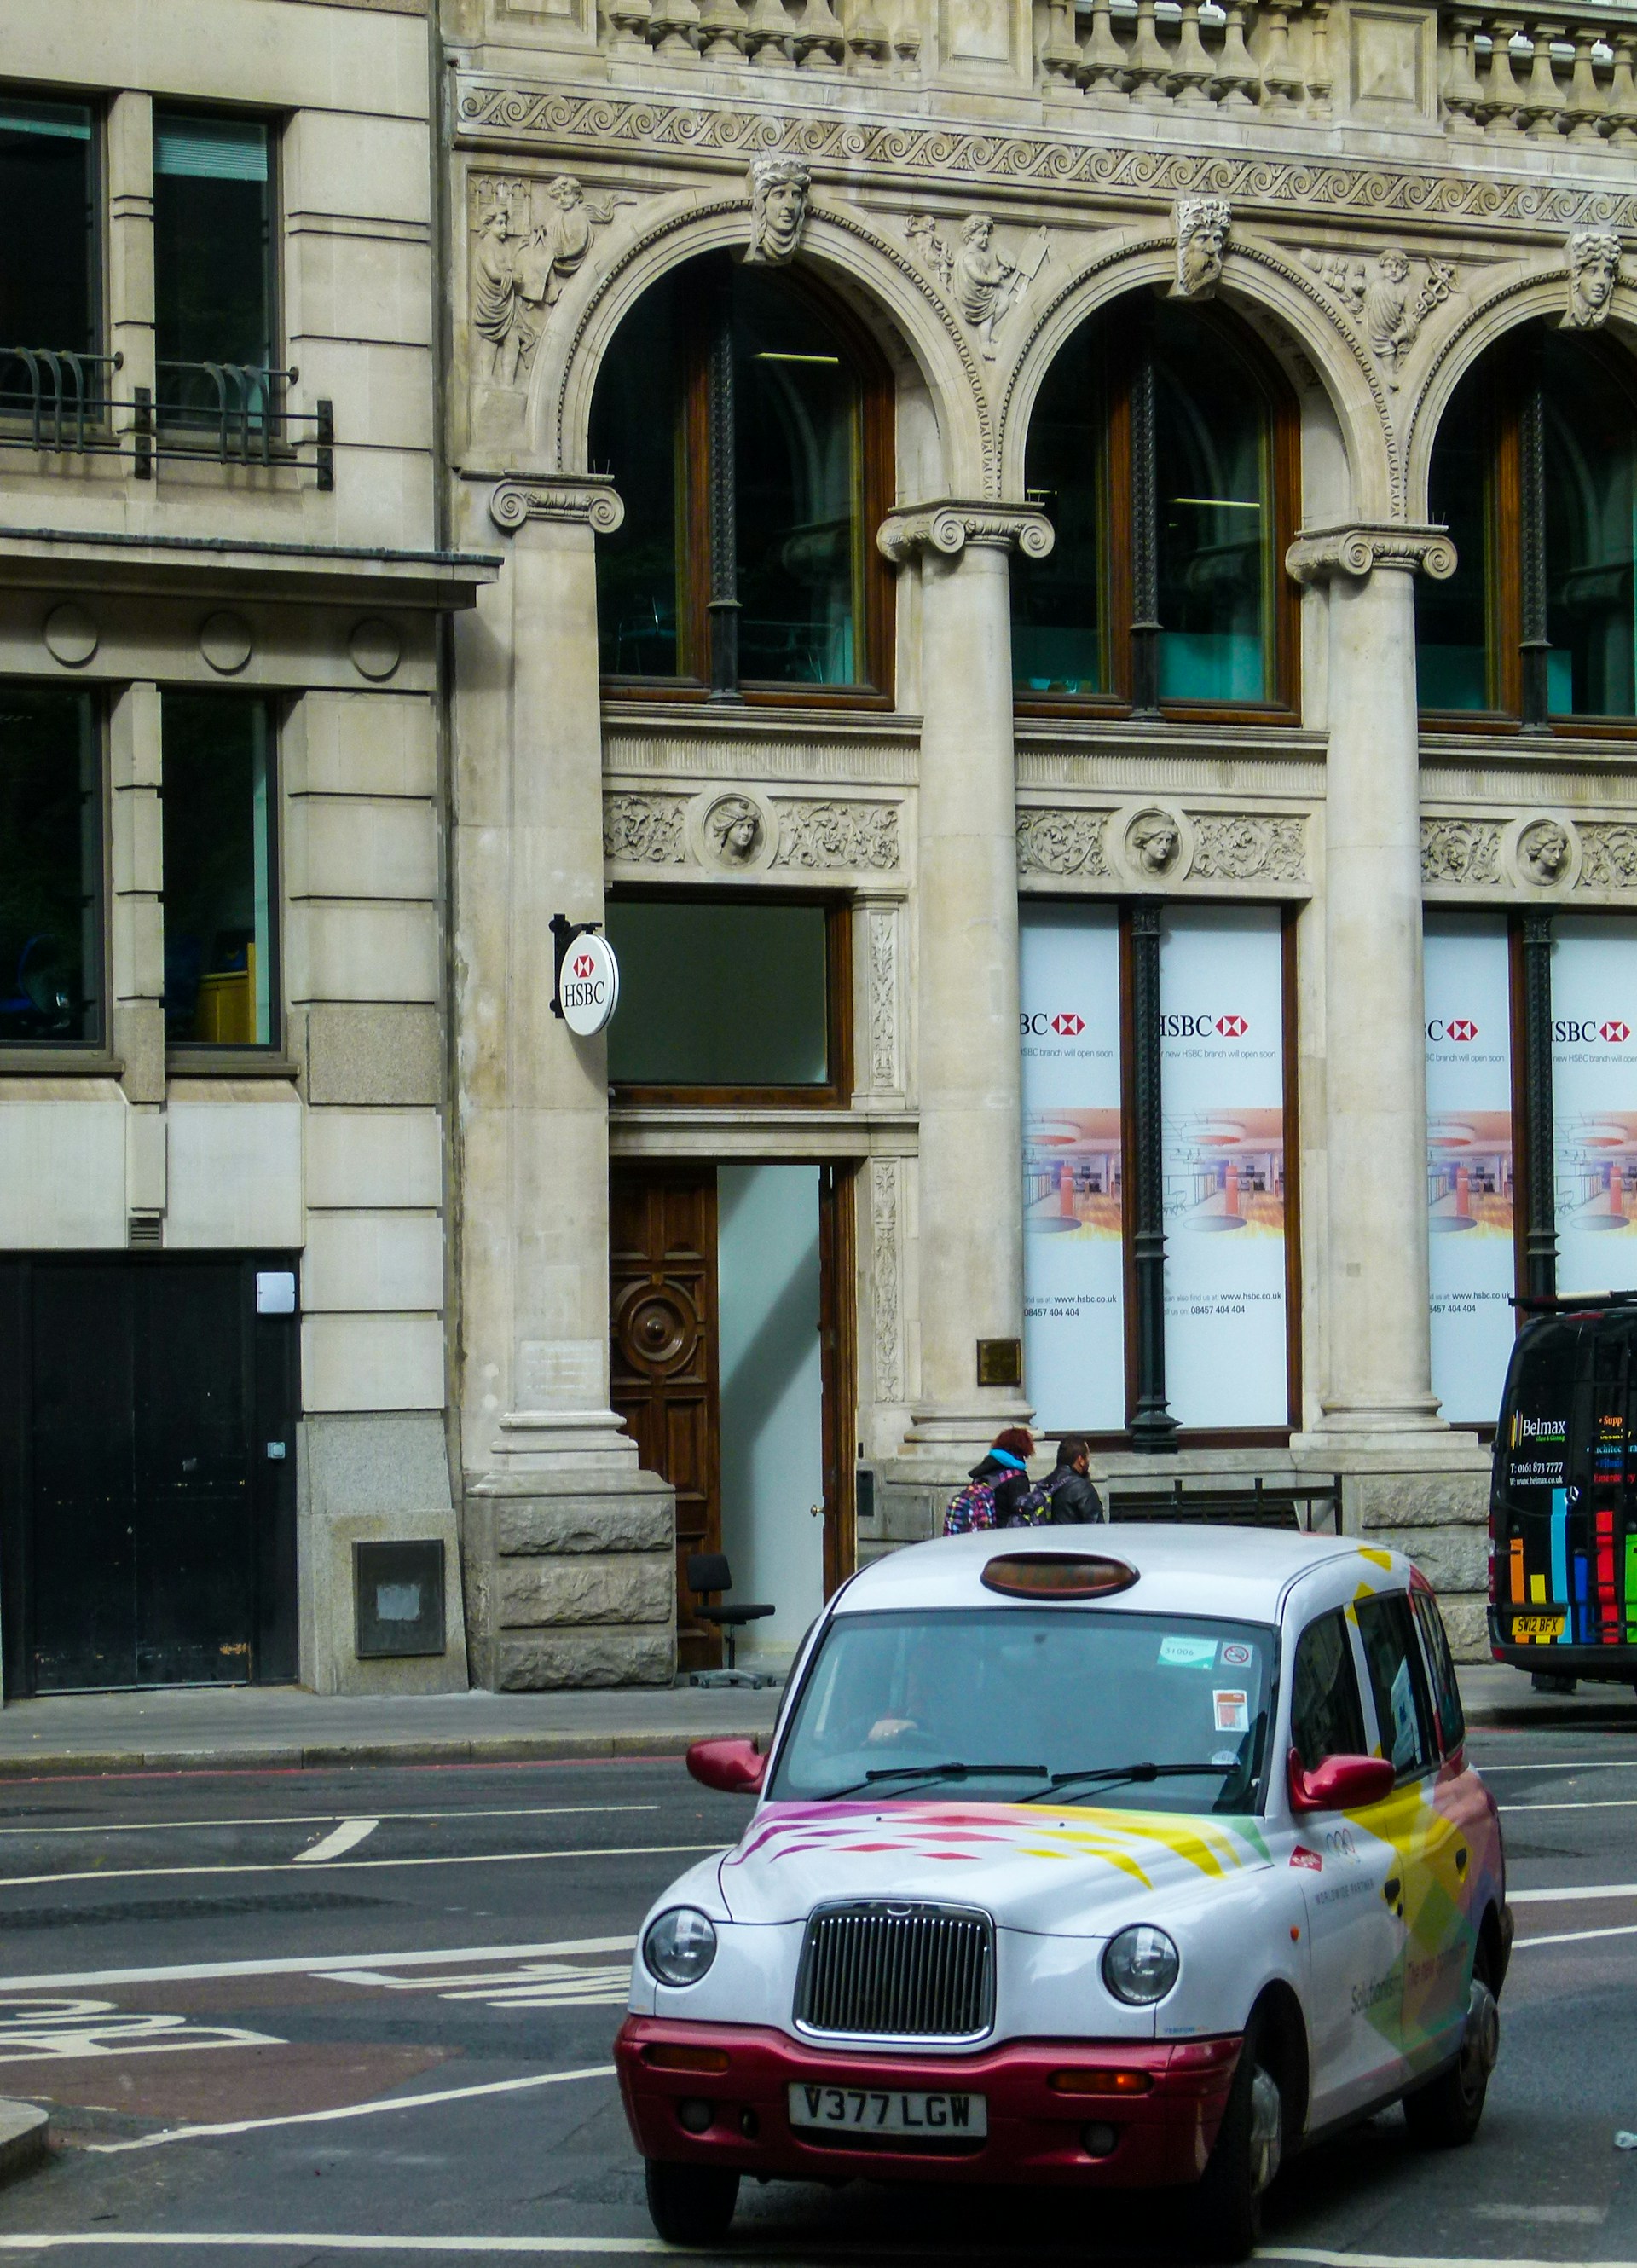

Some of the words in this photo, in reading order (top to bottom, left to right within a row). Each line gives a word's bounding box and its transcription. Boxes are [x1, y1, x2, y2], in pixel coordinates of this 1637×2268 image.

[564, 981, 605, 1008] HSBC
[1039, 1048, 1062, 1057] branch
[1064, 1048, 1076, 1057] will
[1077, 1050, 1094, 1059] open
[1182, 1049, 1203, 1058] HSBC
[1205, 1049, 1227, 1058] branch
[1228, 1049, 1240, 1058] will
[1241, 1050, 1258, 1060] open
[1436, 1053, 1458, 1062] branch
[1458, 1053, 1469, 1062] will
[1471, 1055, 1487, 1063] open
[1569, 1054, 1588, 1062] HSBC
[1589, 1054, 1611, 1062] branch
[1611, 1054, 1622, 1062] will
[1054, 1294, 1117, 1304] www.hsbc.co.uk
[1220, 1292, 1281, 1301] www.hsbc.co.uk
[1452, 1291, 1511, 1300] www.hsbc.co.uk
[1024, 1308, 1047, 1316] 08457
[1049, 1308, 1063, 1316] 404
[1065, 1308, 1079, 1316] 404
[1191, 1305, 1213, 1315] 08457
[1215, 1305, 1229, 1314] 404
[1231, 1305, 1245, 1314] 404
[1447, 1305, 1461, 1313] 404
[1462, 1304, 1476, 1313] 404
[1523, 1418, 1566, 1437] Belmax
[1510, 1462, 1517, 1473] T:
[1518, 1462, 1531, 1472] 0161
[1532, 1461, 1545, 1473] 873
[1546, 1461, 1564, 1473] 7777
[1516, 1475, 1563, 1485] www.belmax.co.uk
[1518, 1617, 1537, 1632] SW12
[1539, 1617, 1558, 1632] BFX
[803, 2086, 890, 2126] V377
[901, 2094, 970, 2127] LGW
